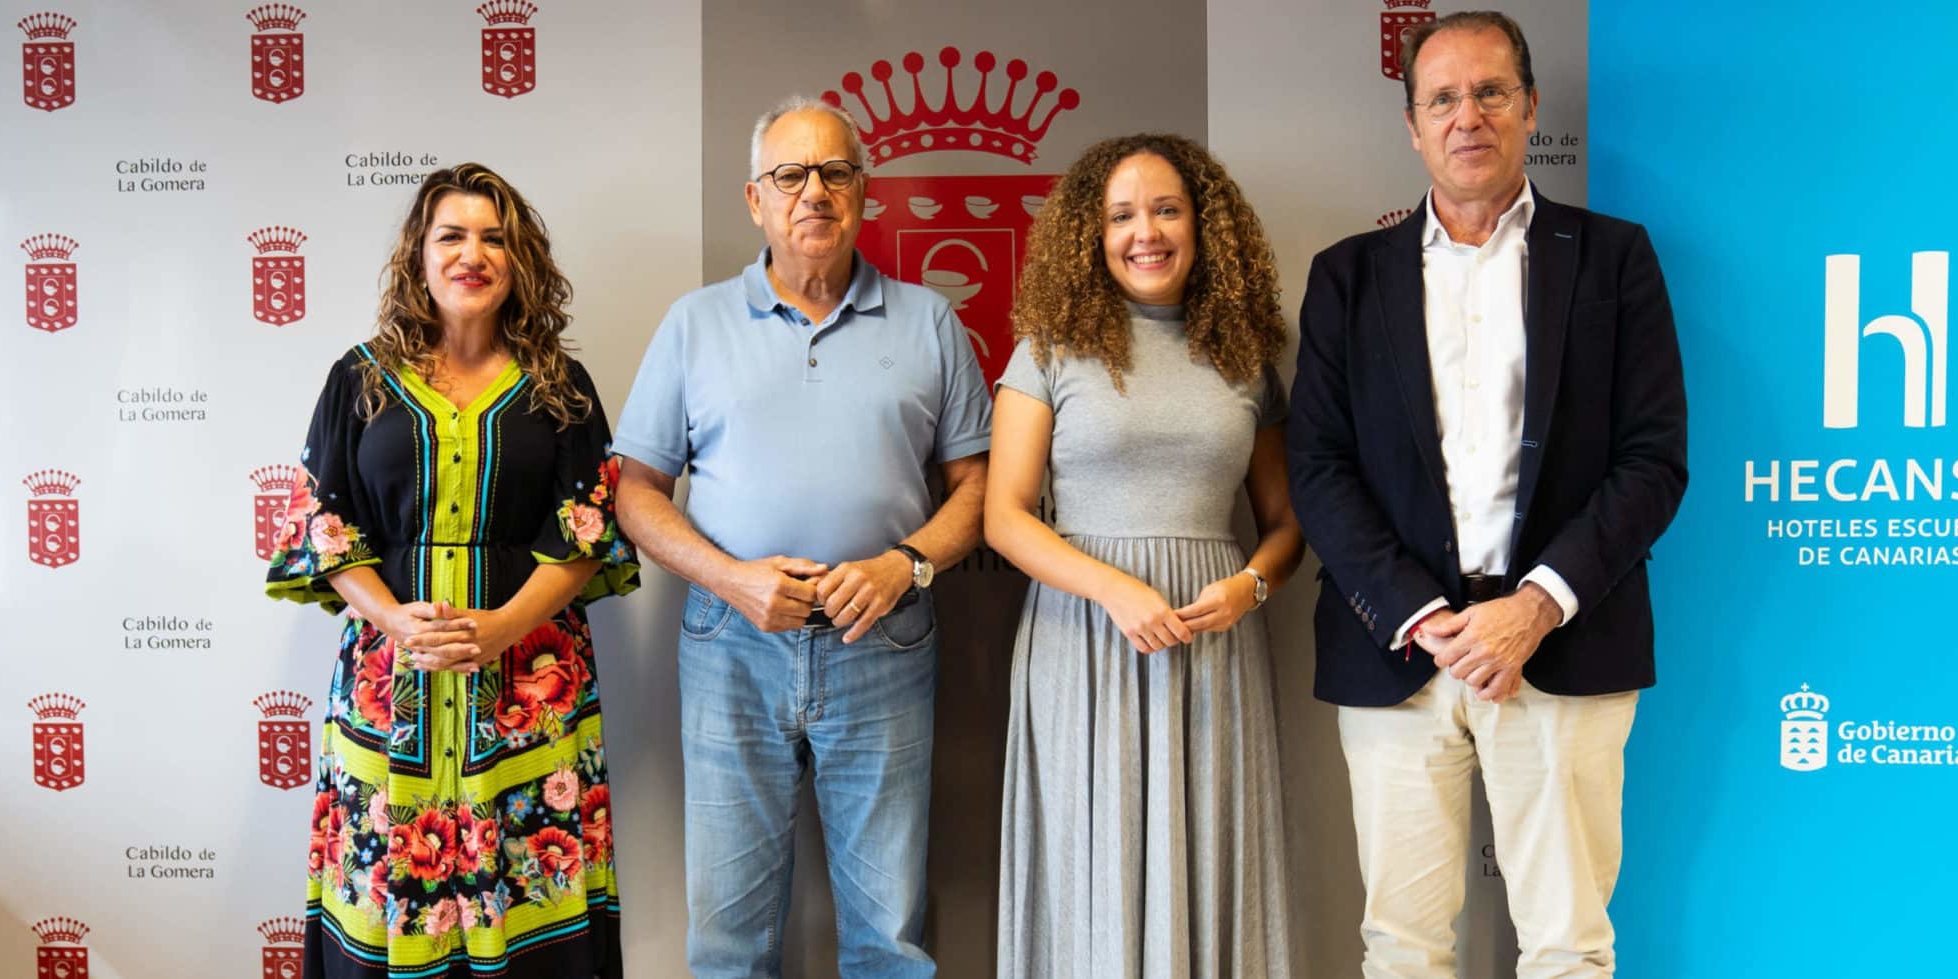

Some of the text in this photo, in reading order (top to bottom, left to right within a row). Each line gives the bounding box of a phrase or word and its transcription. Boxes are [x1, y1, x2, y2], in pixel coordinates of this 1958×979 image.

[1560, 132, 1579, 147] de
[116, 158, 207, 175] Cabildo de
[345, 151, 438, 169] Cabildo de
[1523, 153, 1577, 166] omera
[118, 177, 205, 193] La Gomera
[347, 171, 427, 187] La Gomer
[117, 388, 208, 404] Cabildo de
[119, 406, 206, 422] La Gomera
[1768, 518, 1878, 538] HOTELES
[1799, 547, 1830, 566] DE
[122, 616, 213, 632] Cabildo de
[124, 634, 211, 650] La Gomera
[1838, 720, 1956, 742] Gobierno
[1837, 743, 1958, 765] de Canari
[126, 845, 216, 861] Cabildo de
[128, 863, 215, 880] La Gomera
